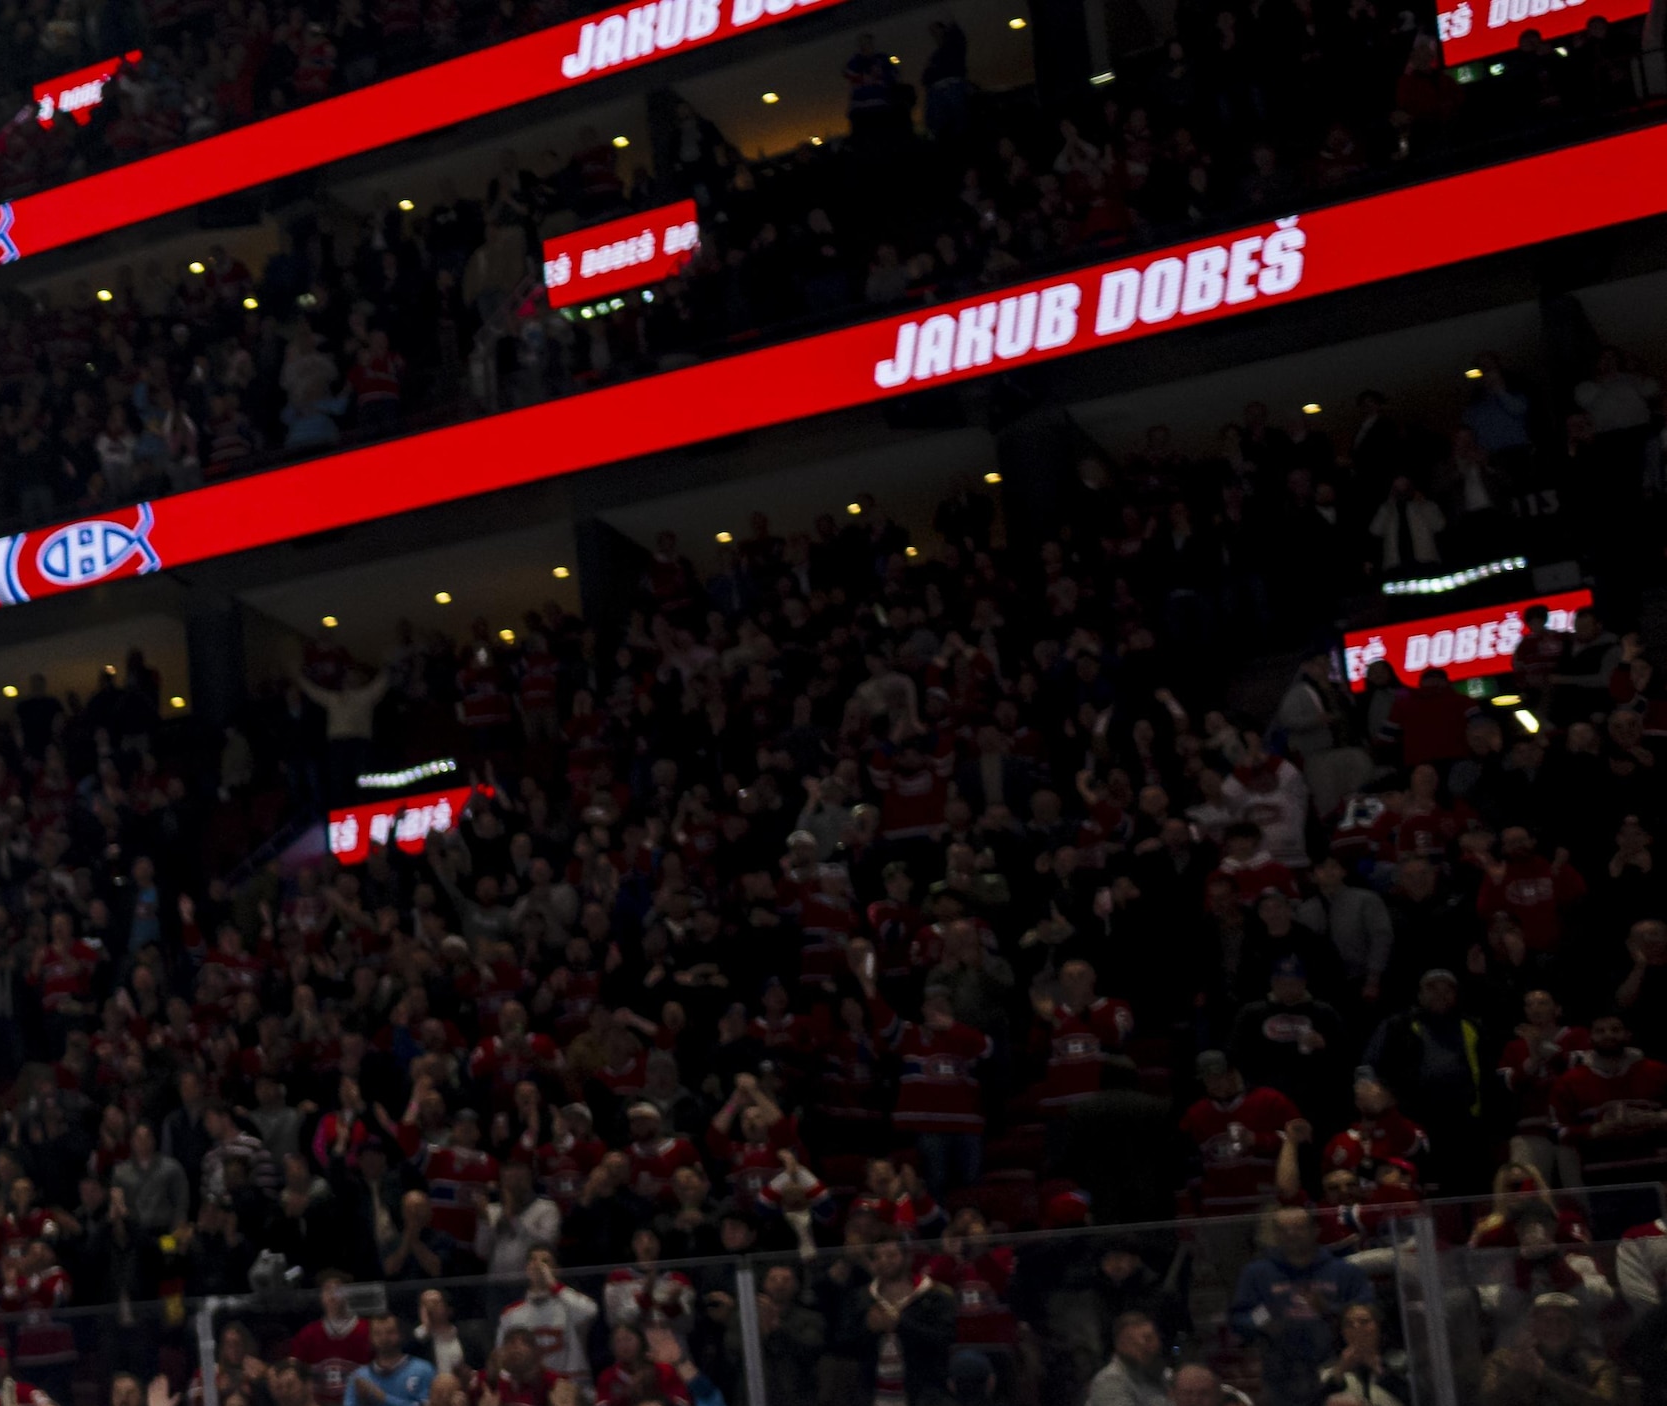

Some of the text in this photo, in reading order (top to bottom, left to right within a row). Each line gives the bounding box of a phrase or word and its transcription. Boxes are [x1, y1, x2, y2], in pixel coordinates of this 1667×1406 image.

[562, 0, 721, 78] JAKUB
[875, 215, 1305, 387] JAKUB DOBEŠ
[1403, 611, 1526, 672] DOBEŠ
